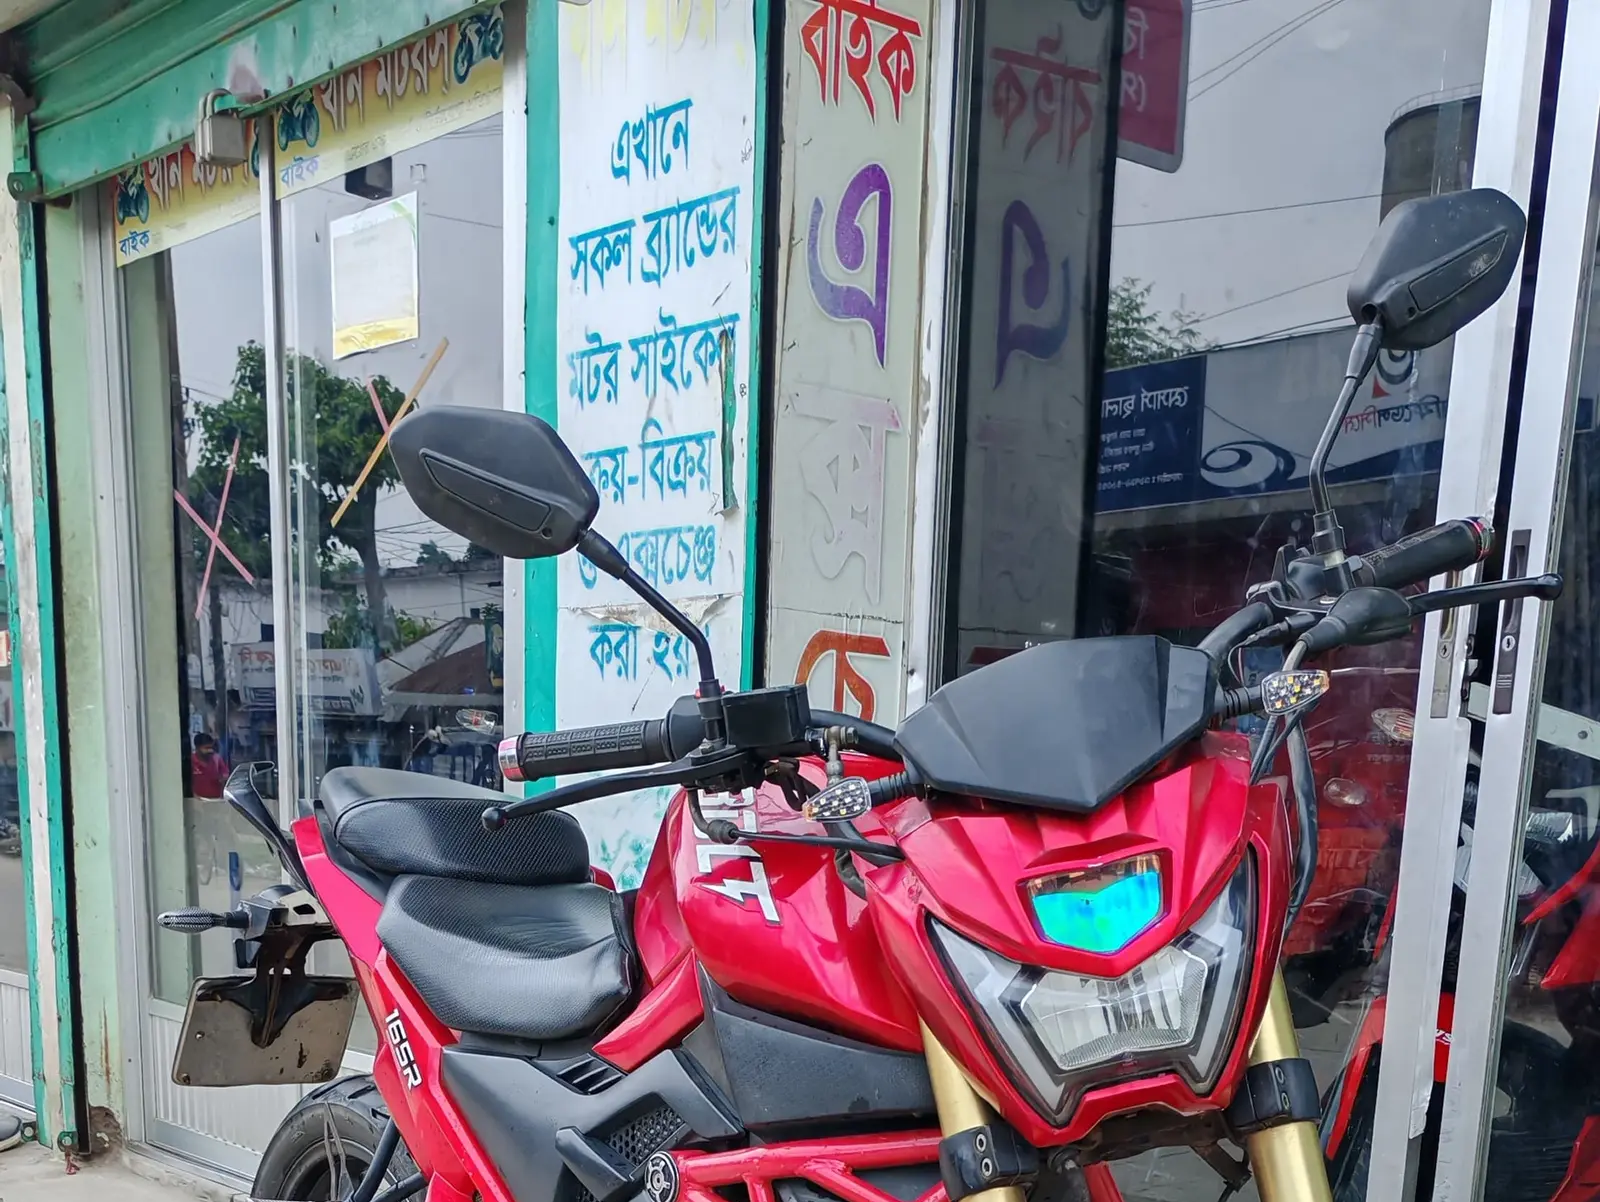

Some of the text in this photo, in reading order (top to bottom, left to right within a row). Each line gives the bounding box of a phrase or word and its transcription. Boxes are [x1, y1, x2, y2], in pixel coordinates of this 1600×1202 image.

[800, 0, 922, 125] বাইক
[279, 155, 320, 187] বাইক
[611, 98, 693, 185] এখানে
[118, 230, 150, 257] বাইক
[568, 219, 637, 295] সকল
[807, 163, 892, 369] এ
